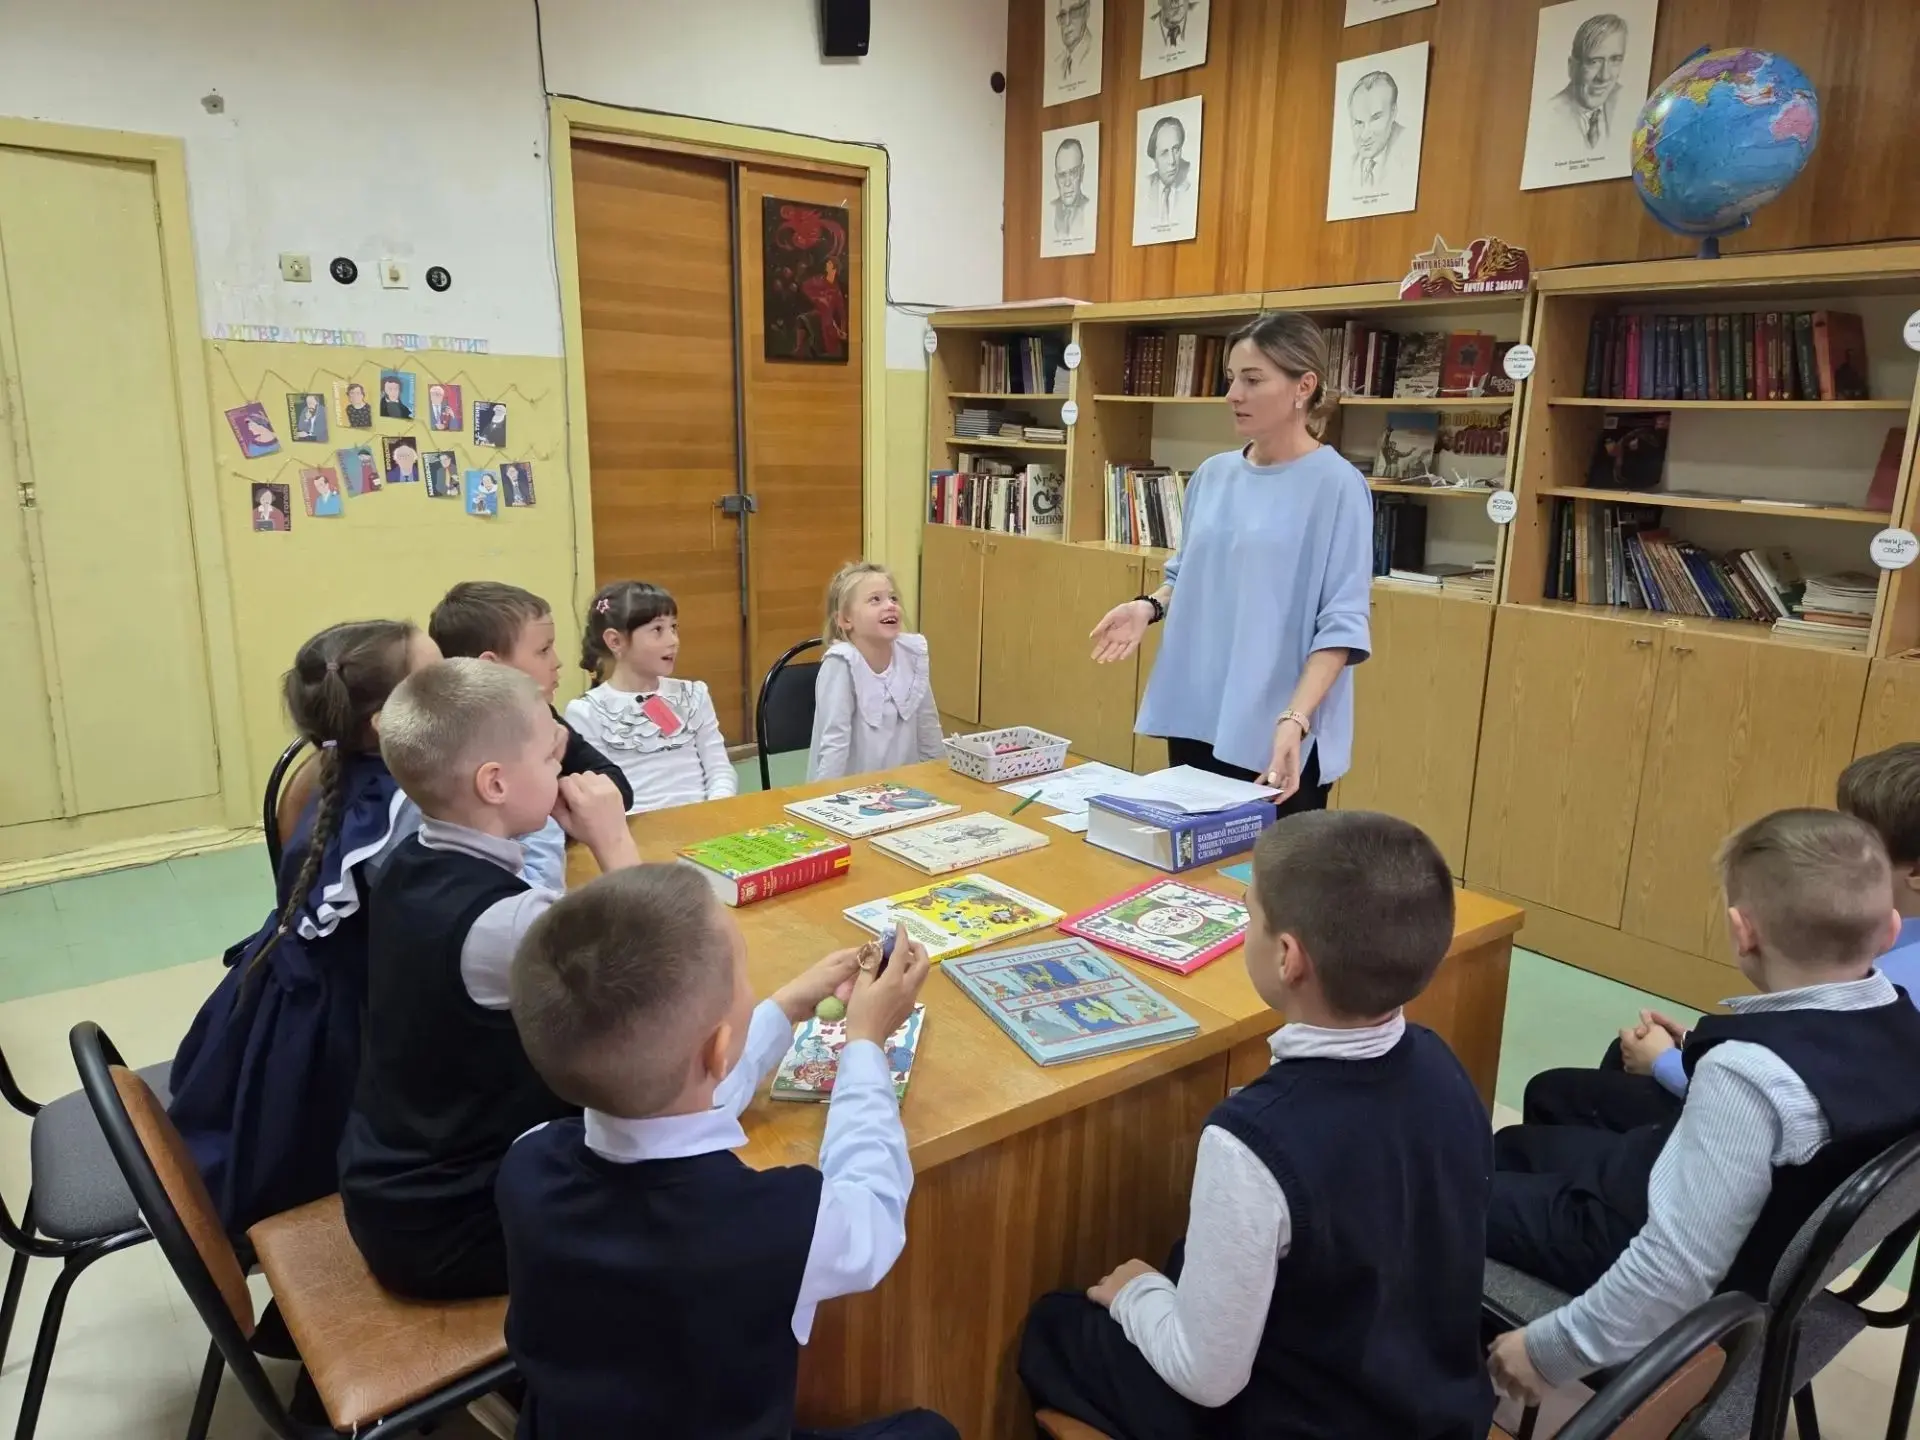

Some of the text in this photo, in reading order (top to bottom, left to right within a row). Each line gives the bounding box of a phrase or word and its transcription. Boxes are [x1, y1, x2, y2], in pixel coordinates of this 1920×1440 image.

[1413, 260, 1432, 270] НИКТО
[1433, 259, 1441, 269] НЕ
[1463, 280, 1524, 293] НИЧТО НЕ ЗАБЫТО
[1197, 827, 1227, 843] БОЛЬШОЙ
[1227, 819, 1262, 837] РОССИЙСКИЙ
[1198, 847, 1223, 860] СЛОВАРЬ
